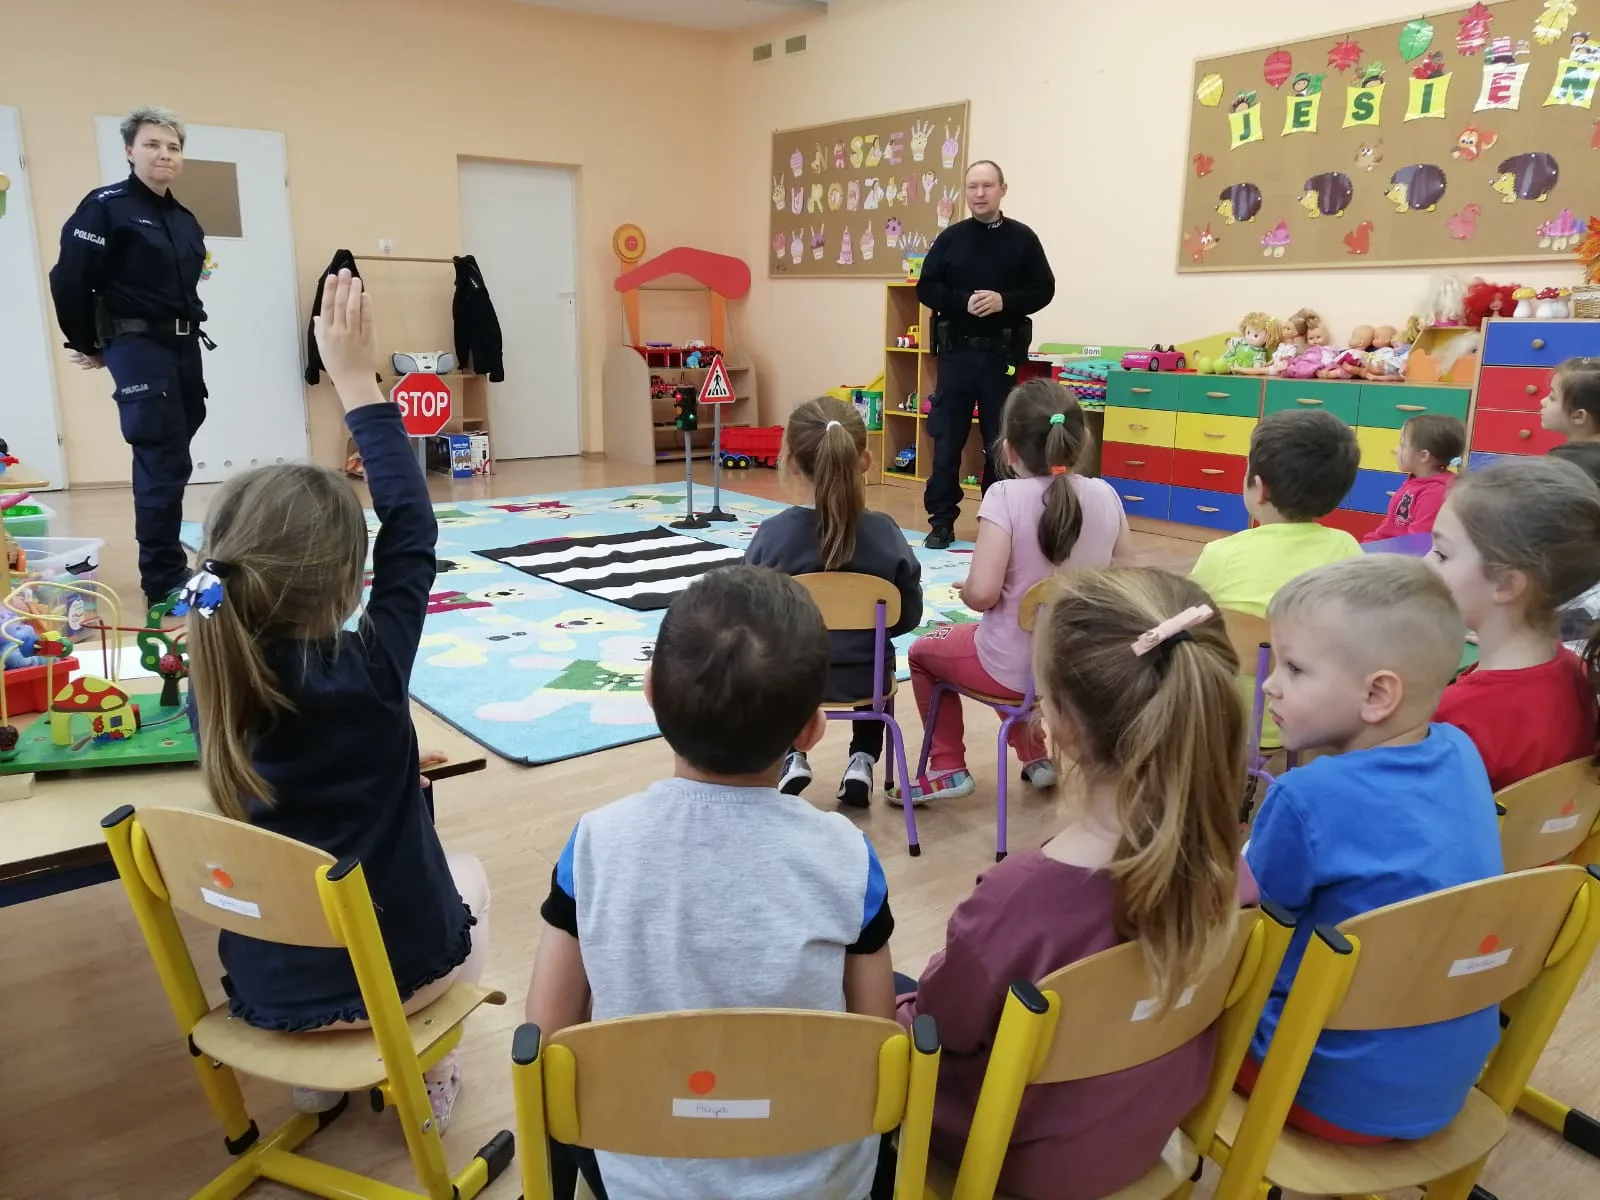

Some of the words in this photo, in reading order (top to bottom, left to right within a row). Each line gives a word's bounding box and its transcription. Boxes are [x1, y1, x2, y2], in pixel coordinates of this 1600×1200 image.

[73, 228, 106, 246] POLICJA
[1083, 347, 1101, 355] dom
[396, 390, 449, 417] STOP
